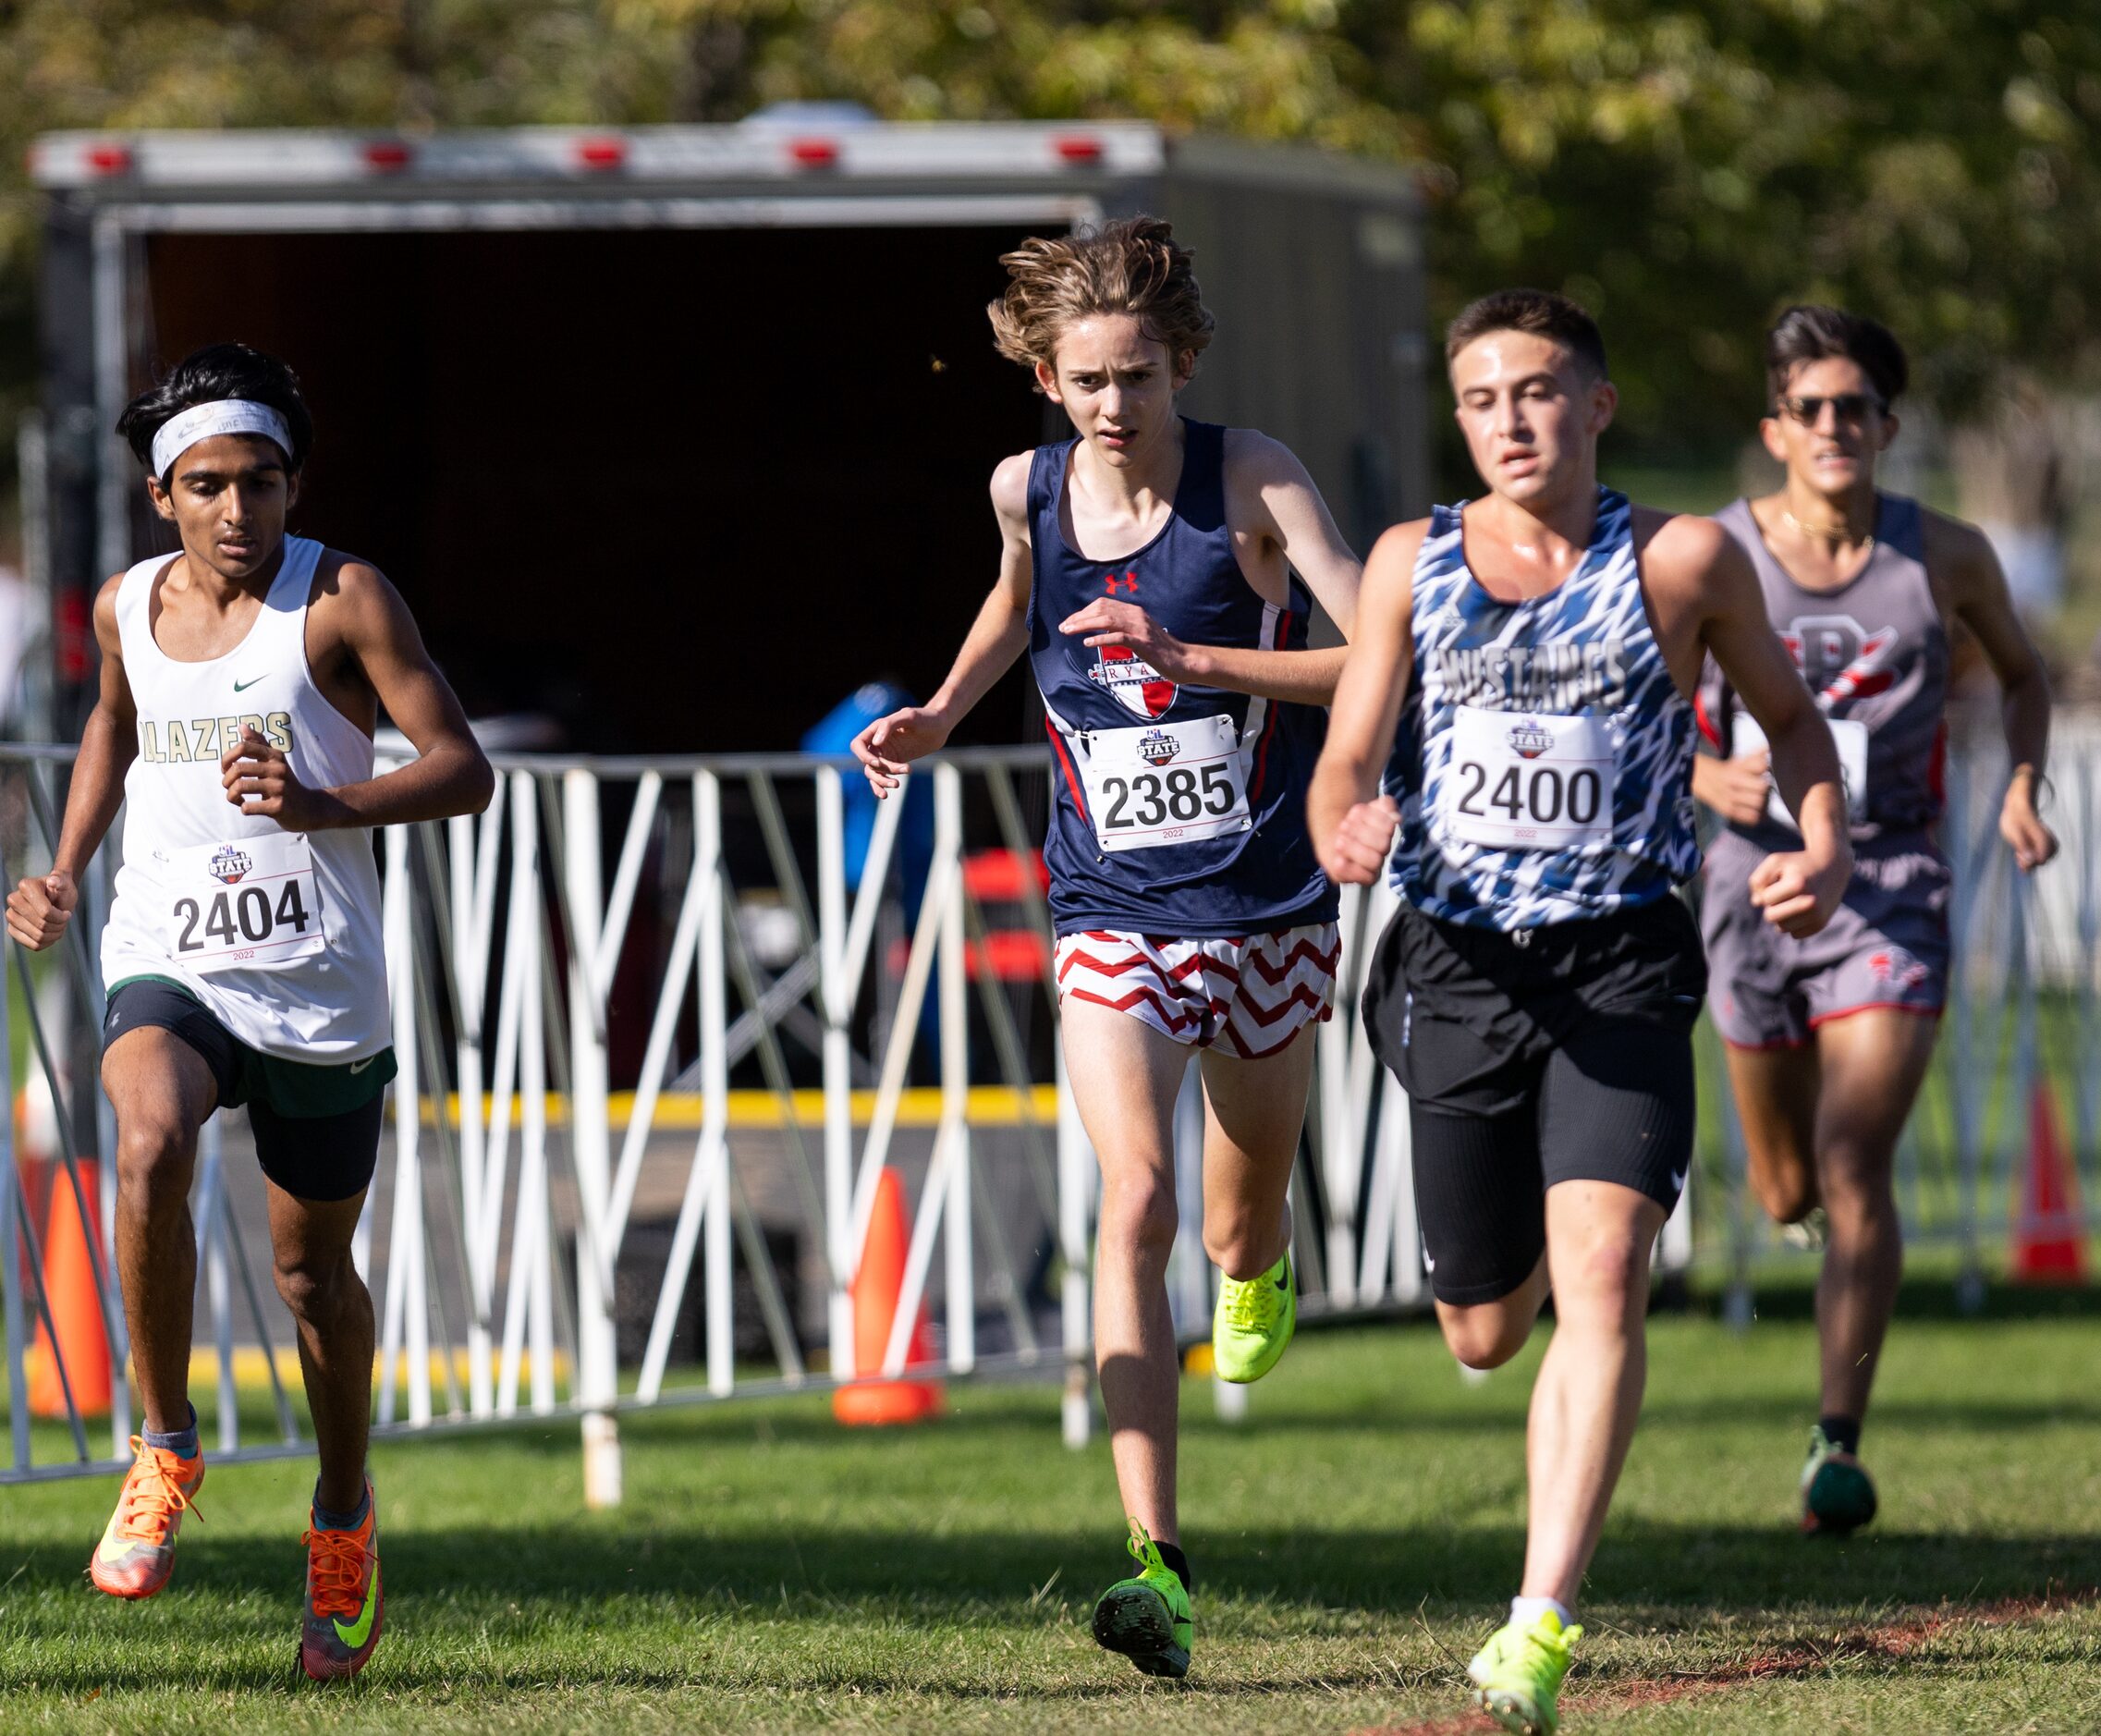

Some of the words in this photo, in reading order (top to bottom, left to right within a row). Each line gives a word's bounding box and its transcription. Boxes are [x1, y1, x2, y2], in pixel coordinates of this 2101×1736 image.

[1438, 639, 1626, 711] MUSTANGS
[1137, 741, 1180, 756] STATE
[1507, 733, 1555, 748] STATE
[1102, 762, 1236, 829] 2385
[1458, 762, 1601, 824] 2400
[1163, 829, 1184, 839] 2022
[1514, 828, 1538, 838] 2022
[209, 857, 252, 874] STATE
[173, 880, 310, 953] 2404
[233, 950, 255, 961] 2022
